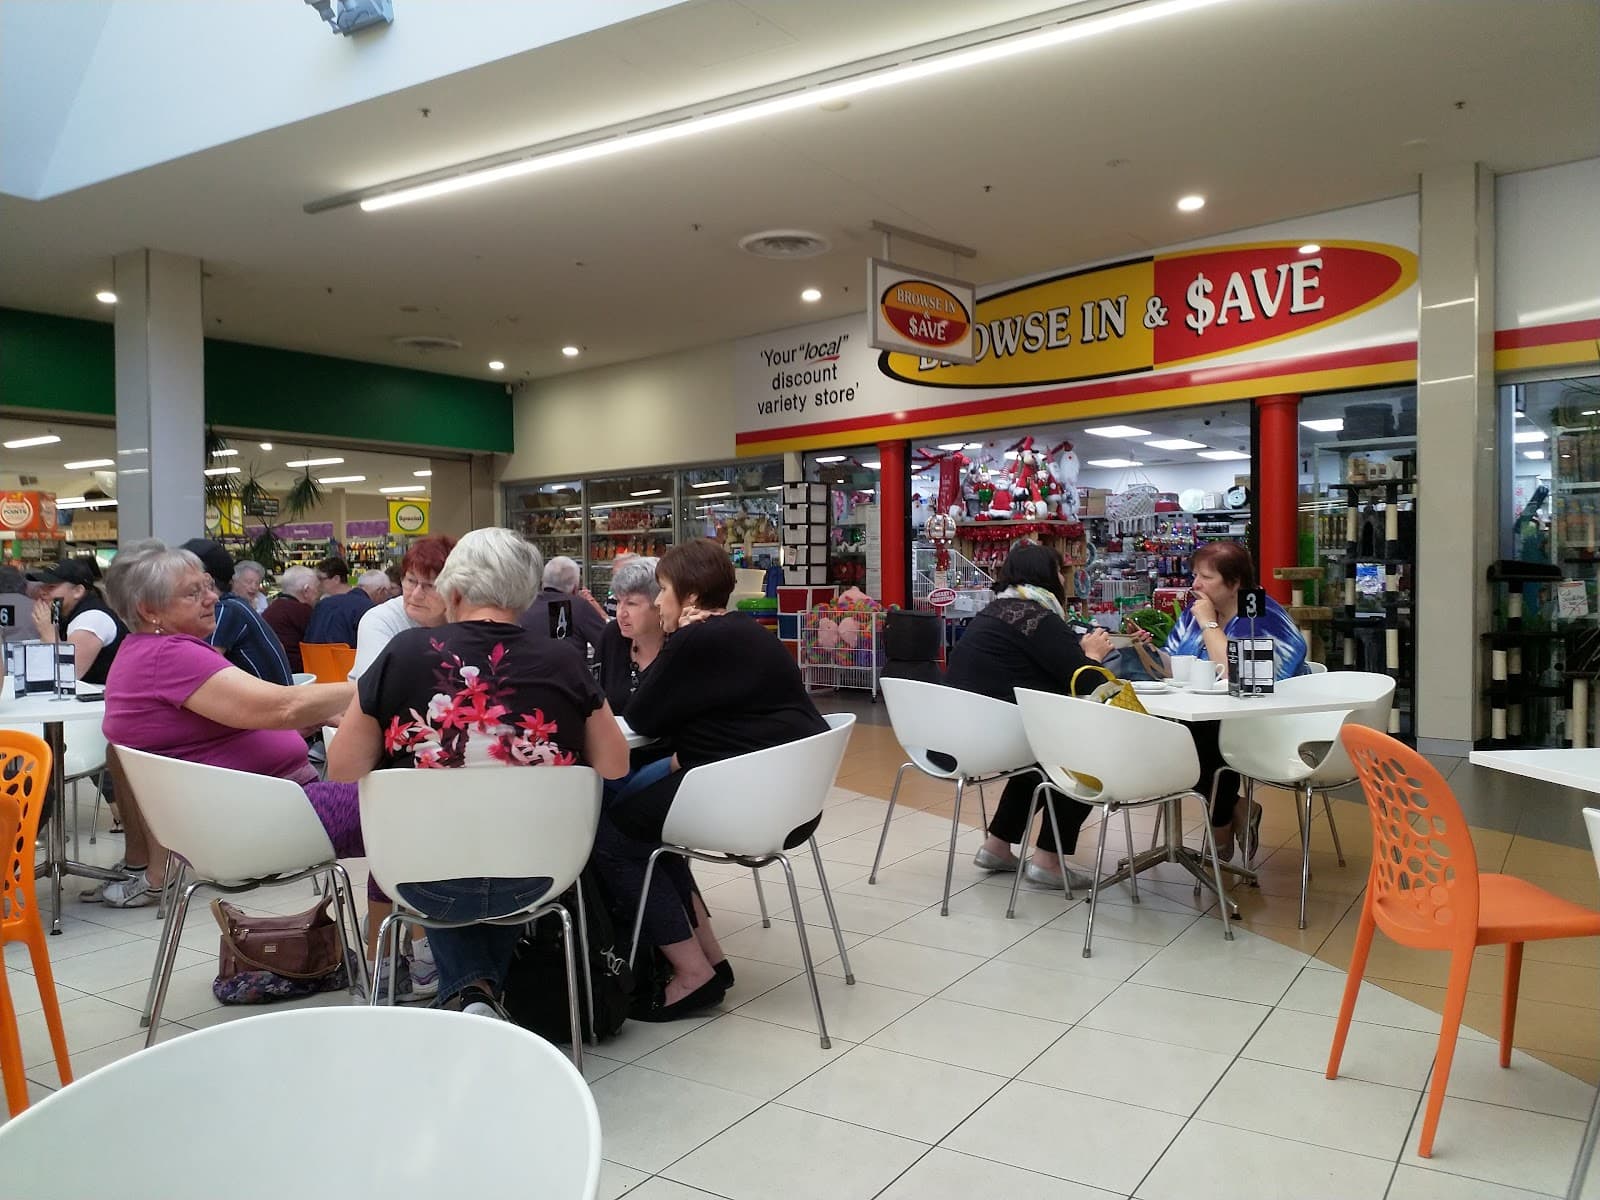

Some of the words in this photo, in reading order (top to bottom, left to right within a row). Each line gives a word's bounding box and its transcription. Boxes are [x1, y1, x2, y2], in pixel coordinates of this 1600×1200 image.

[897, 288, 942, 311] BROWSE
[944, 300, 956, 313] IN
[1081, 295, 1129, 344] IN
[1143, 296, 1169, 329] &
[1185, 257, 1325, 336] $AVE
[923, 310, 931, 320] &
[909, 314, 949, 341] $AVE
[772, 363, 838, 390] discount
[757, 395, 807, 415] variety
[0, 608, 9, 625] 6
[1246, 593, 1257, 617] 3
